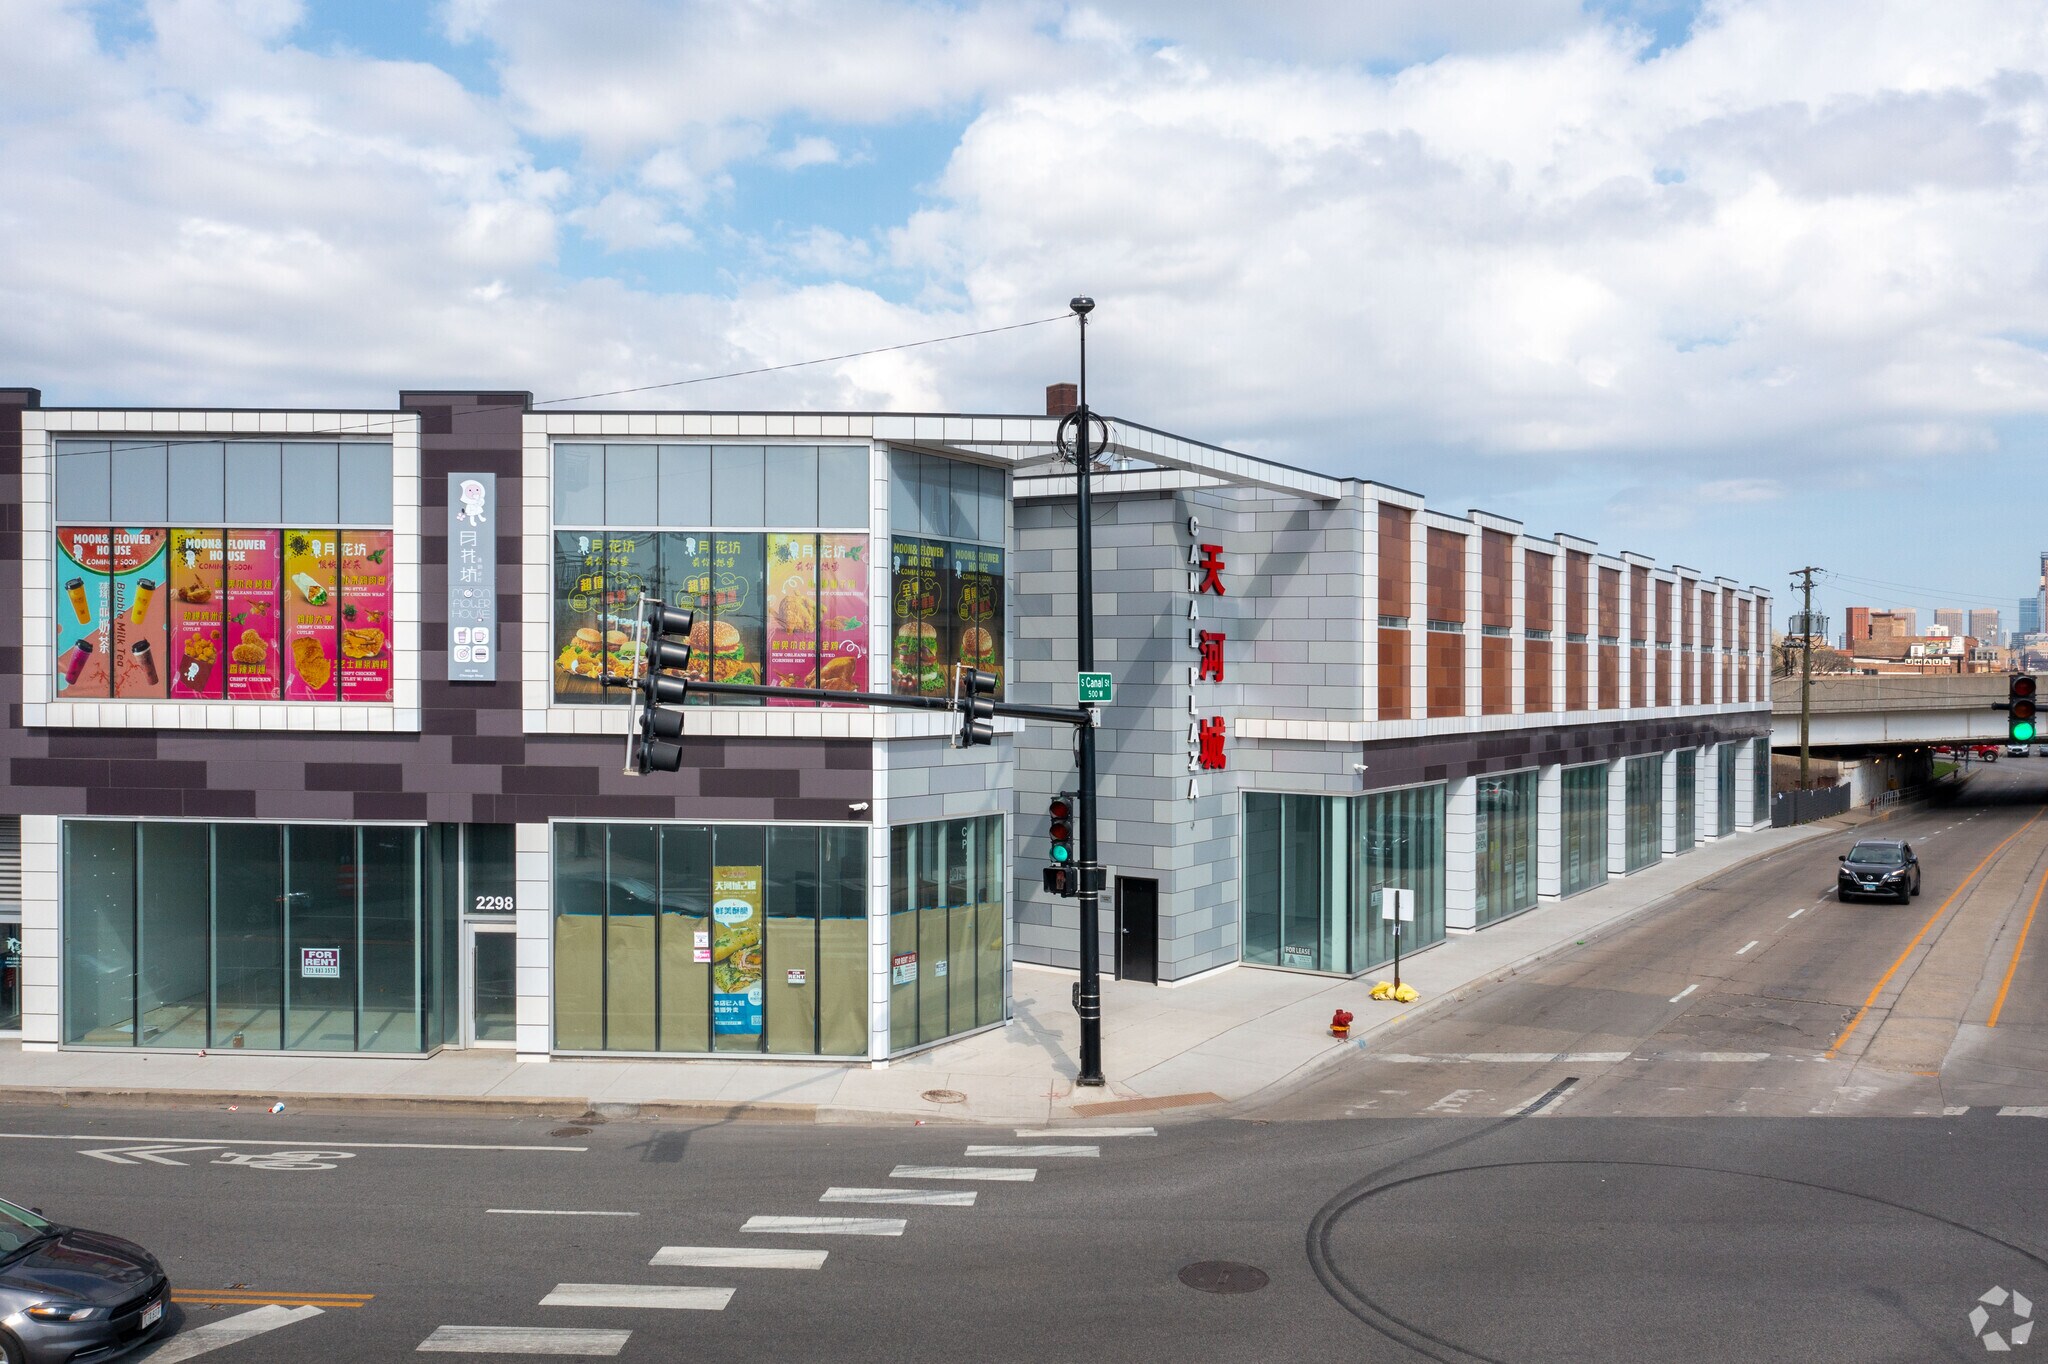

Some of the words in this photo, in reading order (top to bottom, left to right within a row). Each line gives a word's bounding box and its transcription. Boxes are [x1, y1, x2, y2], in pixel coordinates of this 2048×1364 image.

[73, 534, 109, 544] MOON&
[113, 534, 151, 544] FLOWER
[185, 538, 223, 549] MOON&
[227, 539, 266, 550] FLOWER
[97, 545, 131, 555] HOUSE
[324, 542, 366, 556] 月花坊
[592, 539, 635, 553] 月花坊
[699, 541, 741, 554] 月花坊
[802, 544, 846, 559] 月花坊
[893, 543, 918, 555] MOON&
[920, 545, 944, 558] FLOWER
[210, 550, 245, 561] HOUSE
[908, 556, 932, 567] HOUSE
[979, 551, 999, 564] FLOWER
[968, 562, 988, 573] HOUSE
[1187, 516, 1200, 649] CANAL
[116, 582, 126, 619] Bubble
[116, 622, 126, 645] Milk
[116, 649, 126, 667] Tea
[1199, 543, 1227, 770] 天河城
[1081, 678, 1085, 687] S
[1086, 676, 1103, 688] Canal
[1104, 678, 1110, 687] St
[1088, 690, 1098, 698] 500
[1187, 667, 1200, 799] PLAZA
[475, 895, 514, 910] 2298
[1296, 947, 1311, 956] LEASE
[305, 958, 336, 966] RENT
